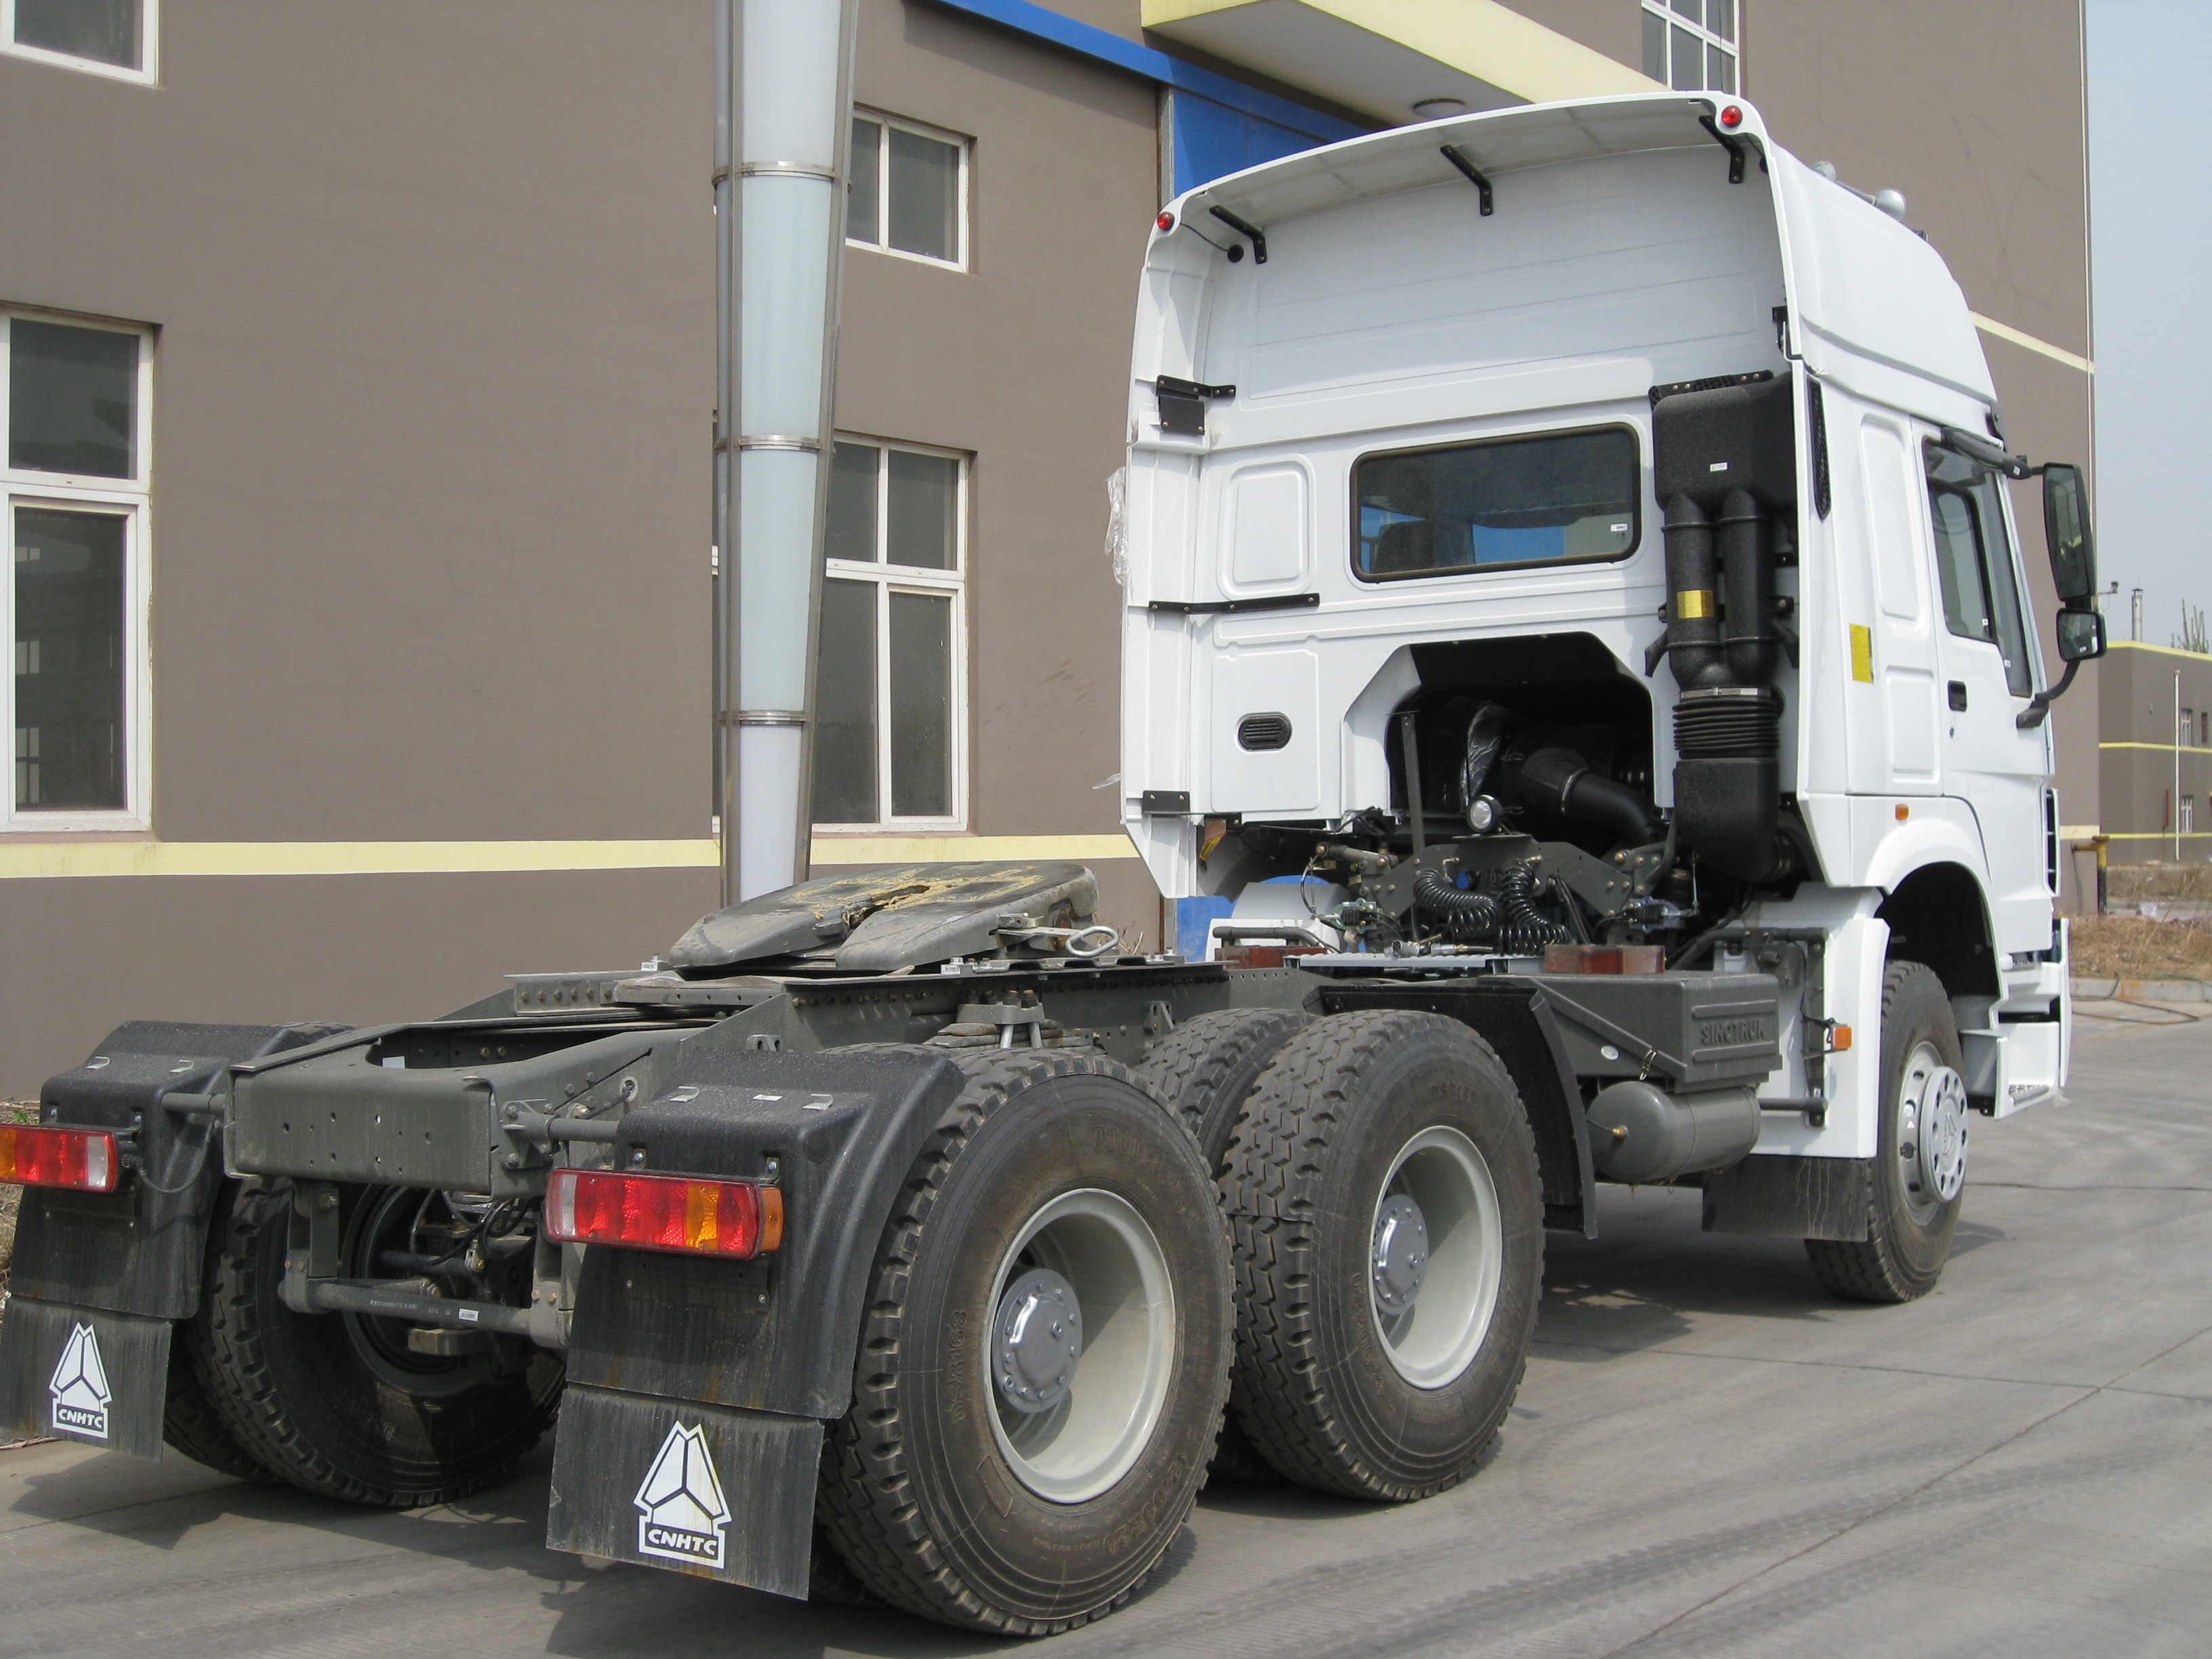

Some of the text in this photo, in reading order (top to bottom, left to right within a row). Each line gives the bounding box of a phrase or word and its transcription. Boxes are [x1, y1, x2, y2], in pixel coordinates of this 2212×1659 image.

[1700, 1019, 1765, 1046] SINOTRUK
[948, 1310, 968, 1426] DSR168
[58, 1408, 103, 1429] CNHTC
[648, 1529, 718, 1556] CNHTC
